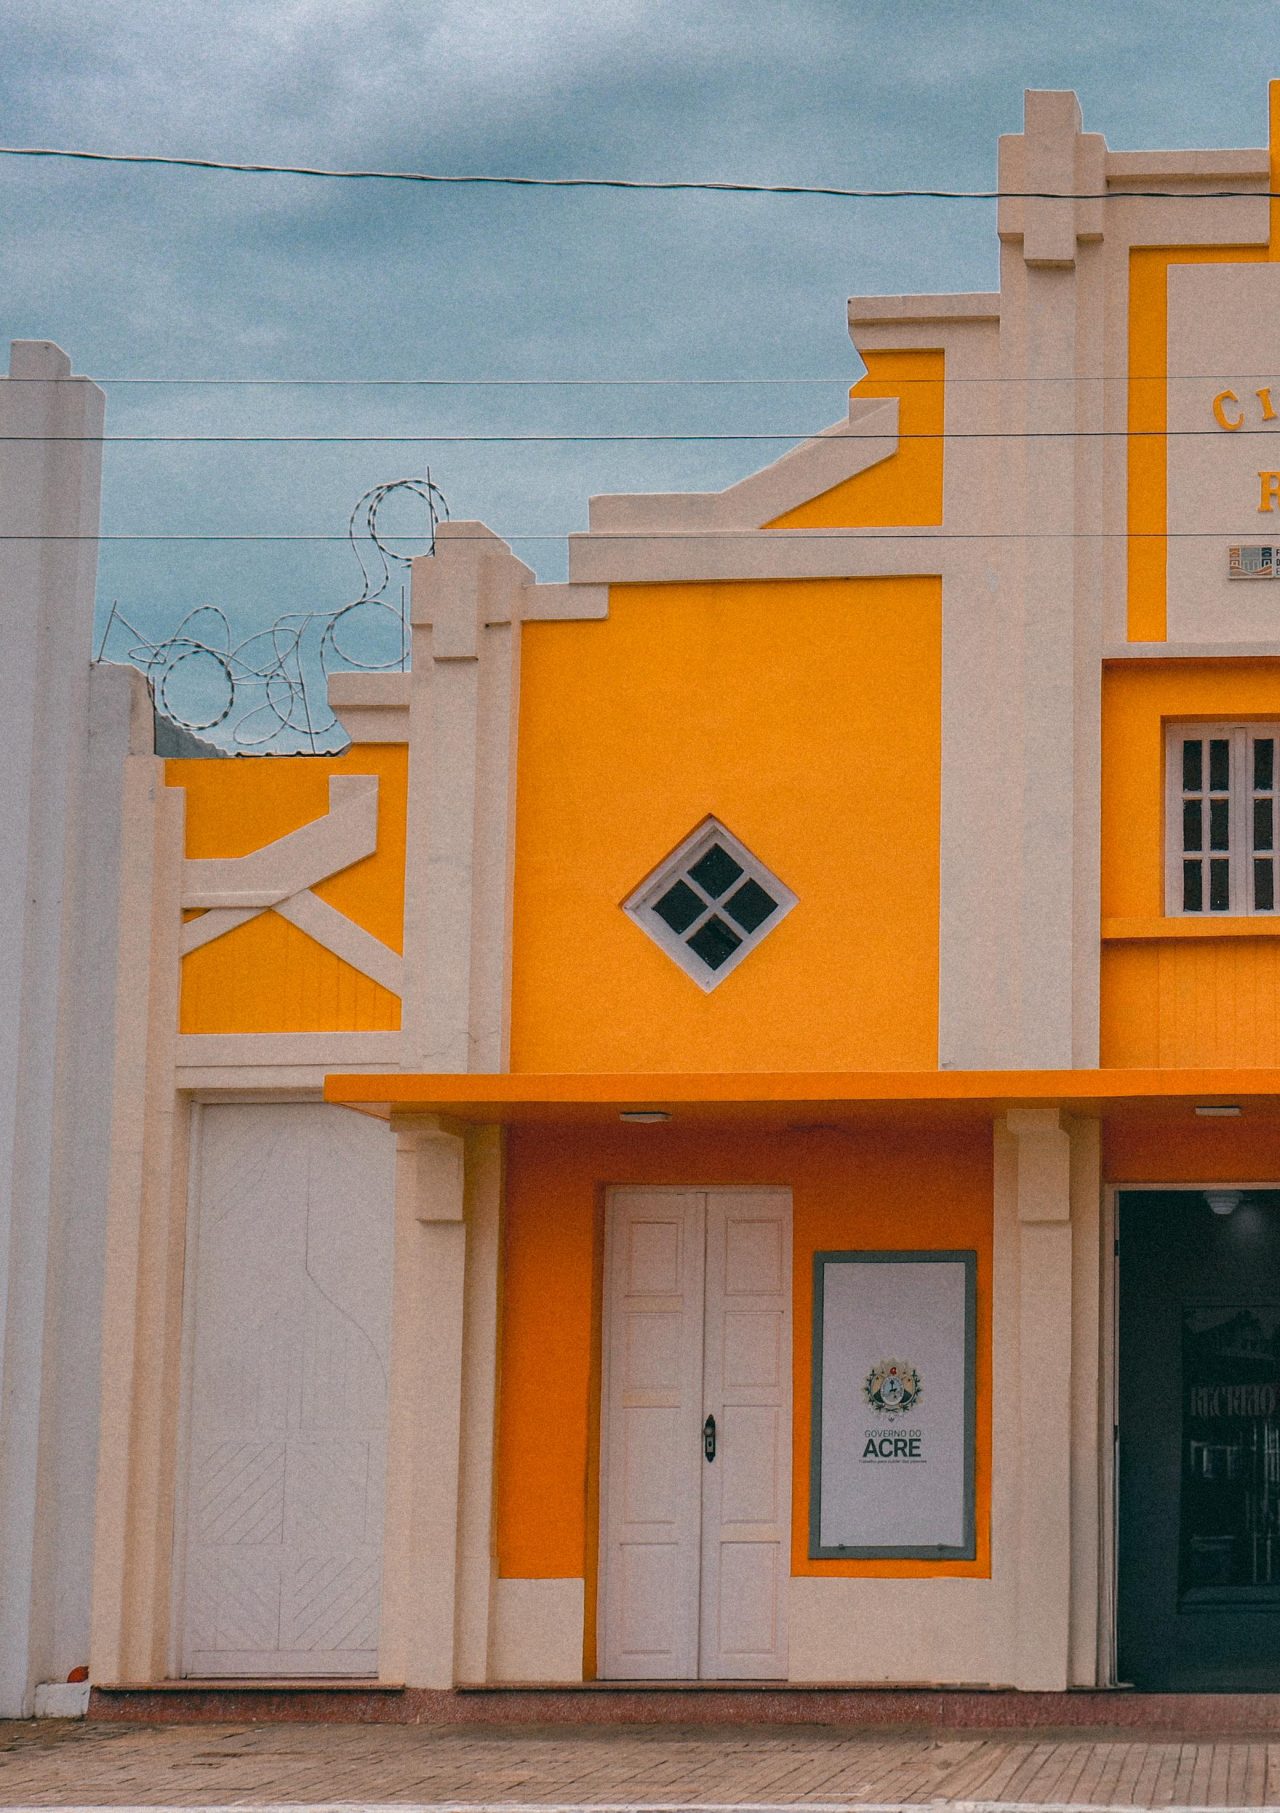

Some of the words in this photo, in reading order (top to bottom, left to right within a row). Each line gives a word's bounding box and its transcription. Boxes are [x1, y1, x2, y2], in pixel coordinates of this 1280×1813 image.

[864, 1429, 907, 1438] GOVERNO
[909, 1429, 922, 1438] DO
[862, 1438, 922, 1458] ACRE
